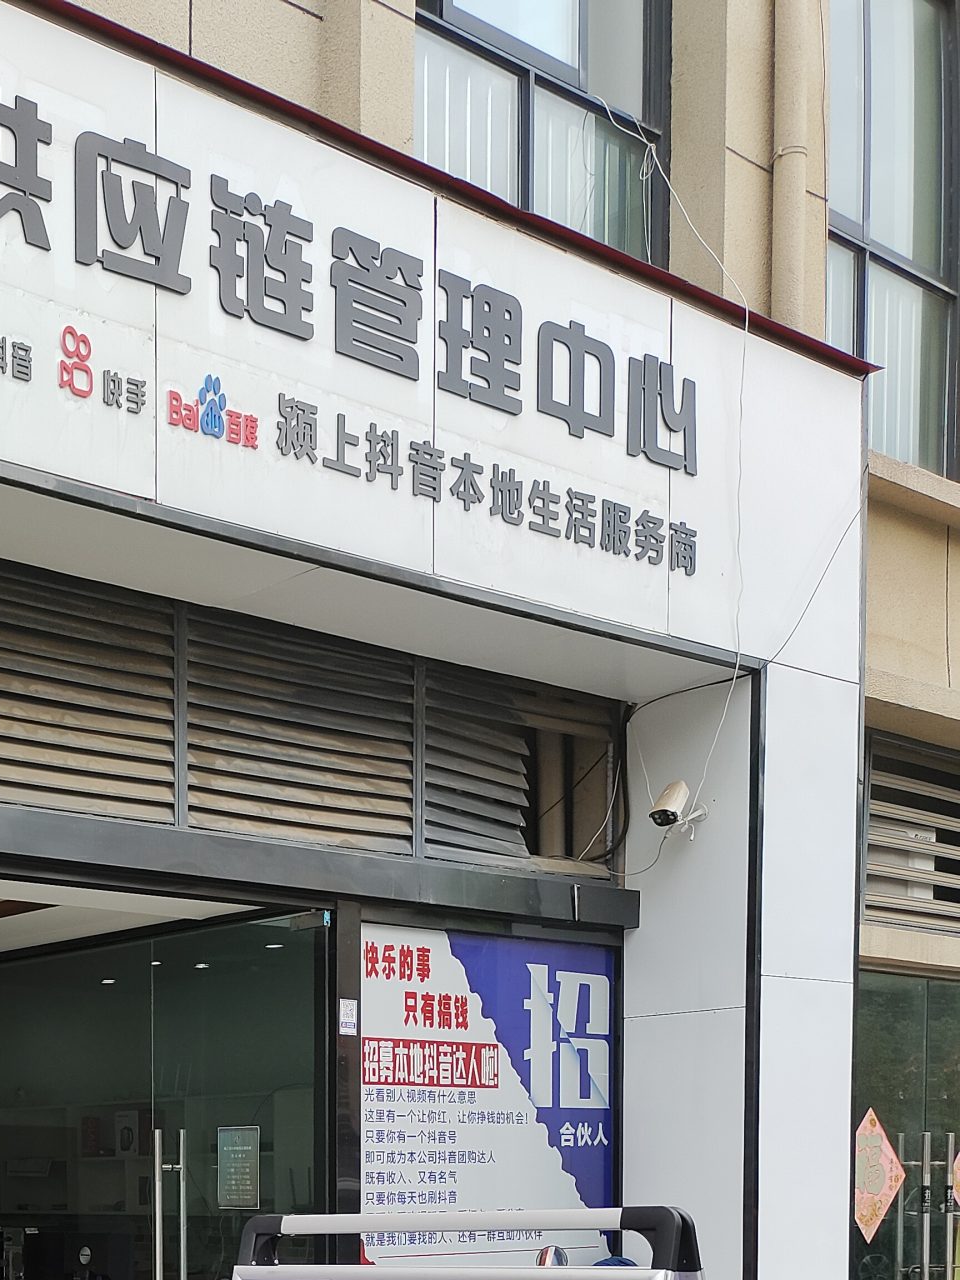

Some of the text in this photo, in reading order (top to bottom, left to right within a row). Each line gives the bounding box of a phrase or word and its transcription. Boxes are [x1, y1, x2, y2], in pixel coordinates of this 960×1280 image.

[103, 370, 146, 414] 快手
[363, 941, 431, 983] 快乐的事
[404, 991, 469, 1031] 只有搞钱
[523, 963, 610, 1109] 招
[363, 1040, 499, 1088] 招募本地抖音达人啦!
[365, 1088, 477, 1105] 光看别人视频有什么意思
[365, 1130, 457, 1145] 只要你有一个抖音号
[559, 1122, 608, 1148] 合伙人
[365, 1150, 496, 1165] 即可成为本公司抖音团购达人
[365, 1170, 457, 1185] 既有收入、又有名气
[365, 1190, 457, 1206] 只要你每天也刷抖音
